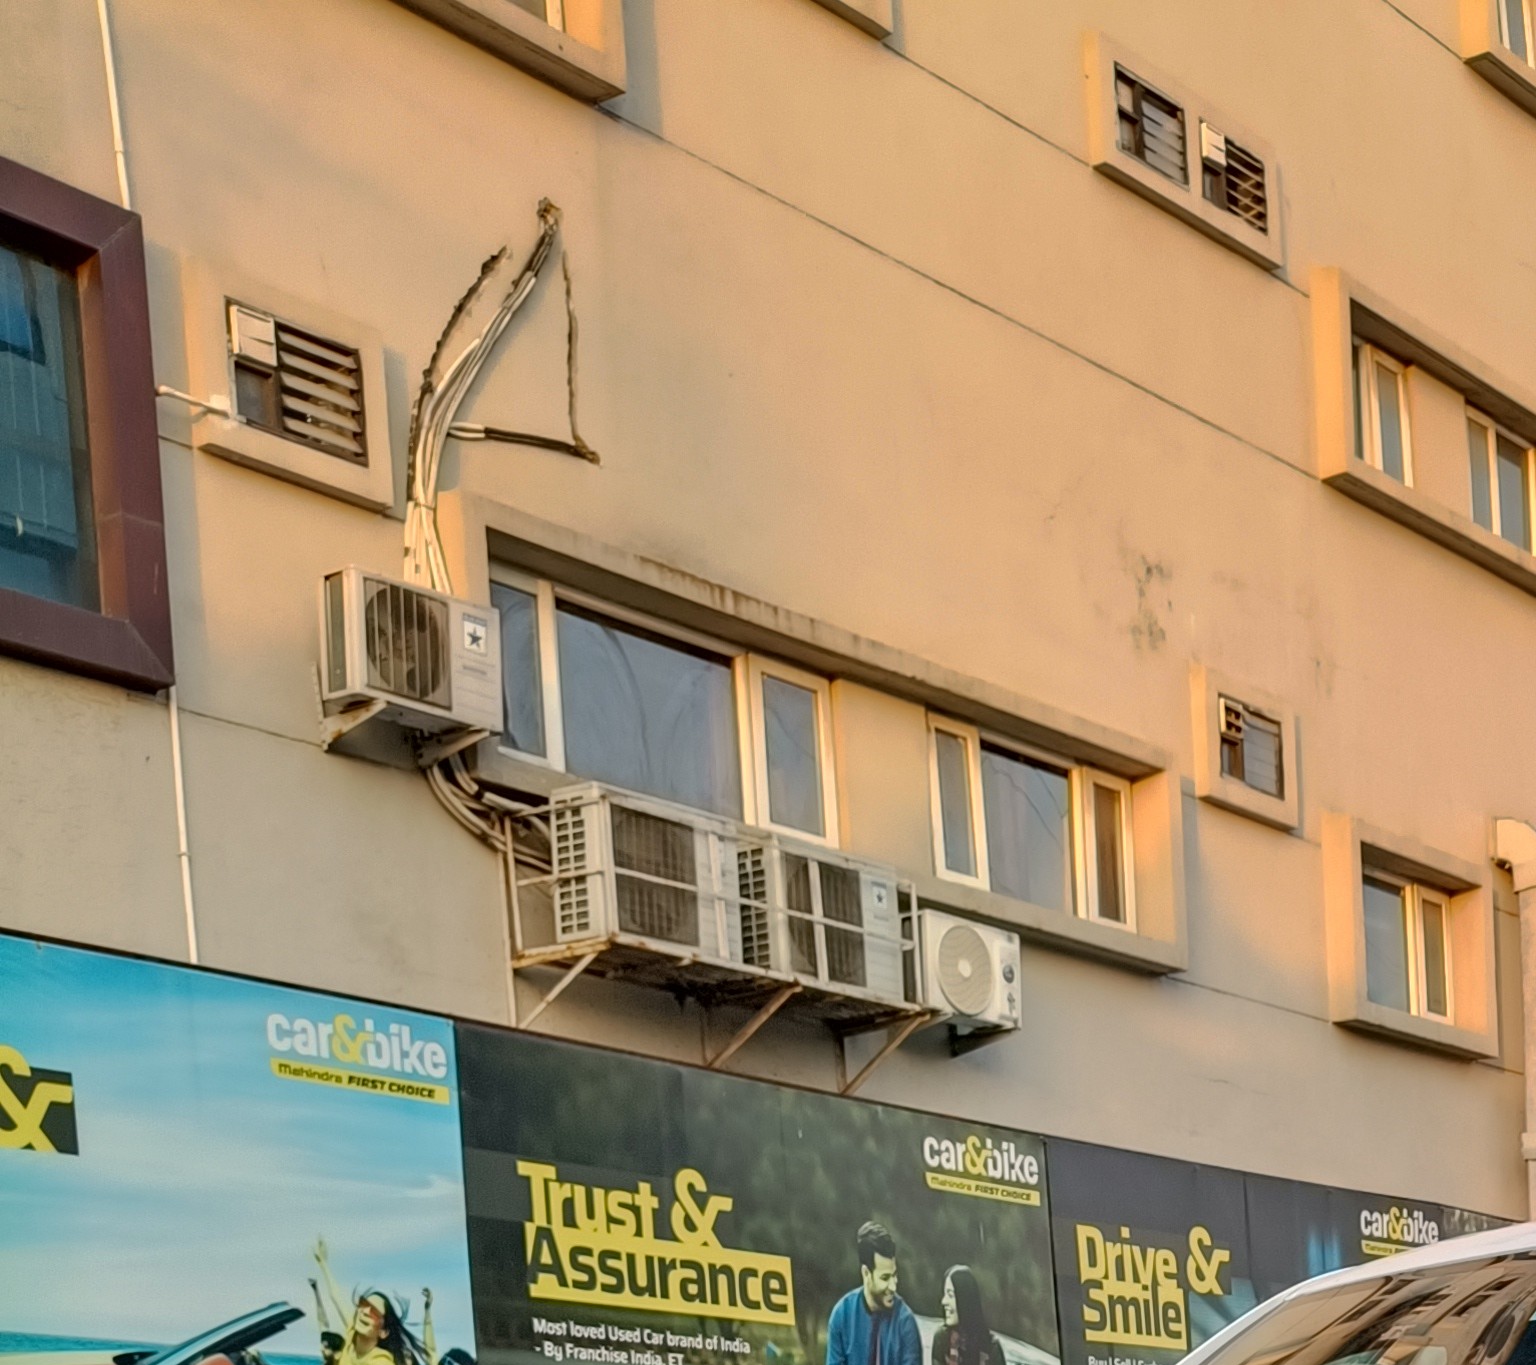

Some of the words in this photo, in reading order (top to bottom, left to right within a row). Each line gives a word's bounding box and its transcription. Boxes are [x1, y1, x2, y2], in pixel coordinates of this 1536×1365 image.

[266, 1013, 448, 1079] car&bike
[0, 1043, 73, 1153] &
[277, 1063, 343, 1084] Mahindra
[348, 1075, 387, 1092] FIRST
[388, 1082, 436, 1099] CHOICE
[923, 1135, 1039, 1185] car&bike
[516, 1159, 659, 1240] Trust
[670, 1167, 734, 1249] &
[974, 1184, 1001, 1197] FIRST
[1001, 1189, 1032, 1202] CHOICE
[1360, 1206, 1439, 1244] car&bike
[528, 1225, 789, 1314] Assurance
[1075, 1223, 1178, 1288] Drive
[1186, 1225, 1231, 1296] &
[531, 1317, 567, 1336] Most
[569, 1320, 605, 1340] loved
[607, 1325, 641, 1343] Used
[643, 1329, 665, 1346] Car
[667, 1331, 703, 1349] brand
[705, 1335, 719, 1351] of
[720, 1337, 751, 1354] India
[1082, 1278, 1183, 1341] Smile
[543, 1340, 563, 1362] By
[564, 1343, 629, 1364] Franchise
